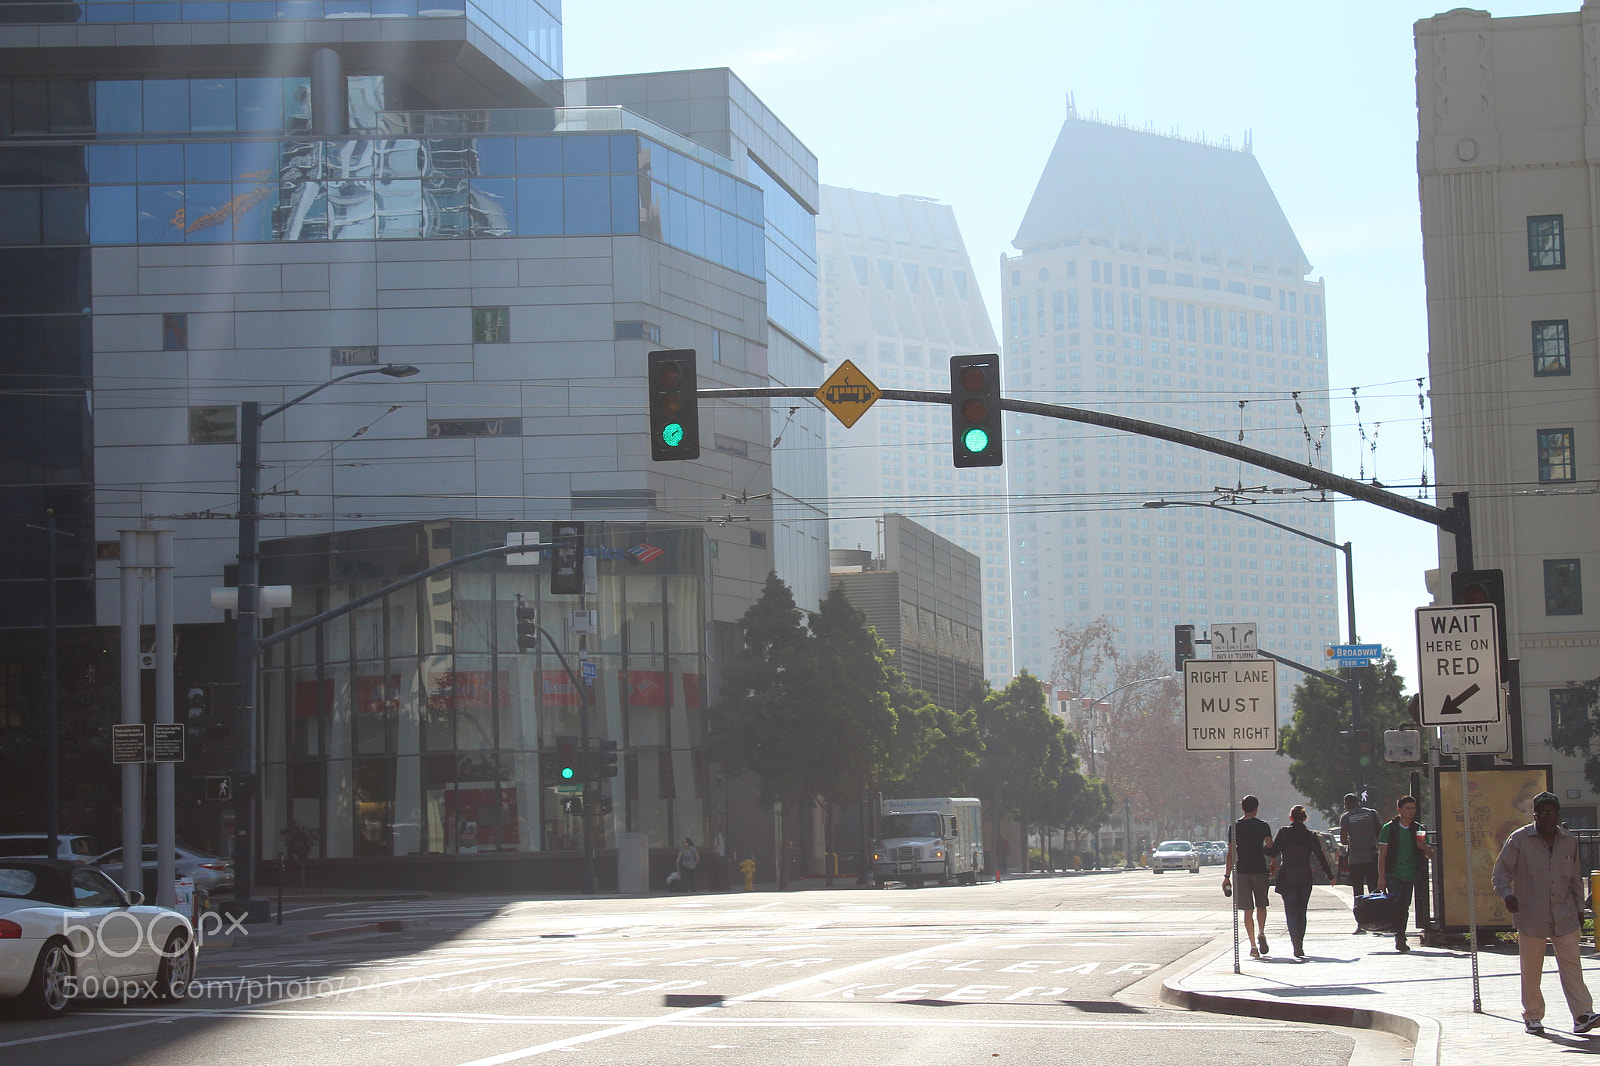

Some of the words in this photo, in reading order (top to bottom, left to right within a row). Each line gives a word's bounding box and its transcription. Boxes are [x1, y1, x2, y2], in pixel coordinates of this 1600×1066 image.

[1430, 615, 1481, 634] WAIT
[1337, 648, 1378, 657] BROADWAY
[1426, 640, 1462, 653] HERE
[1470, 638, 1489, 651] ON
[1436, 657, 1480, 676] RED
[1190, 670, 1228, 684] RIGHT
[1235, 670, 1269, 683] LANE
[1201, 697, 1260, 713] MUST
[1192, 727, 1226, 740] TURN
[1233, 727, 1270, 740] RIGHT
[1464, 735, 1488, 745] NLY
[891, 959, 1163, 975] CLEAR
[810, 983, 1069, 1001] KEEP
